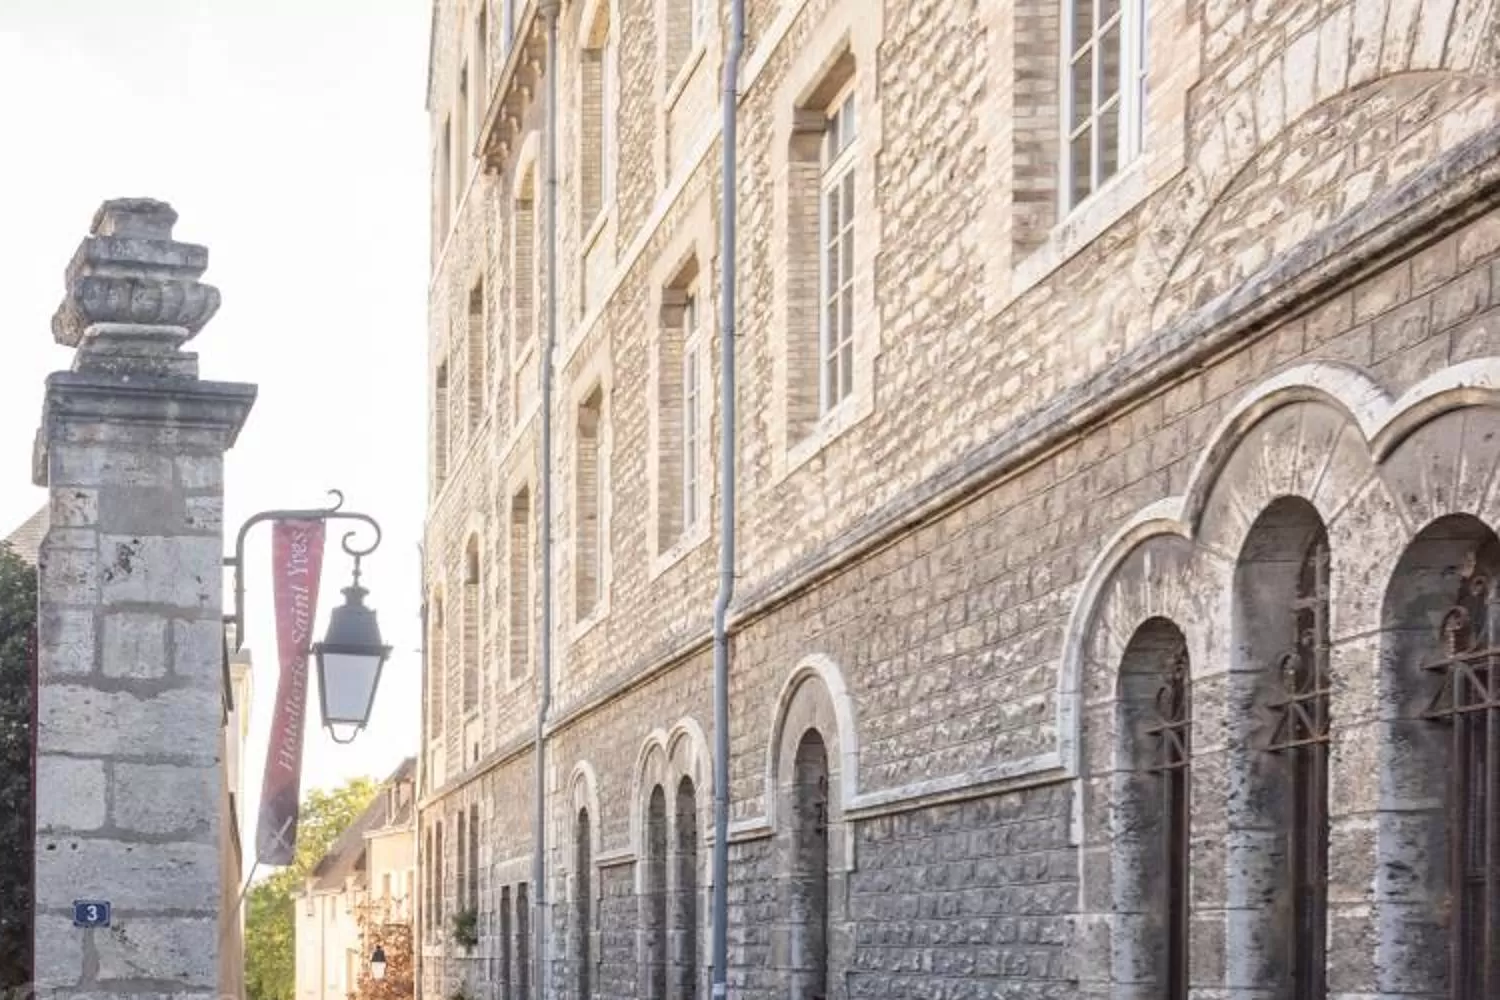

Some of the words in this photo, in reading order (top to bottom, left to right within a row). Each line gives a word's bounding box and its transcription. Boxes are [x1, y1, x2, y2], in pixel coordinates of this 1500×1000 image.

[288, 528, 308, 576] Yves
[291, 585, 308, 643] Saint
[87, 905, 97, 921] 3
